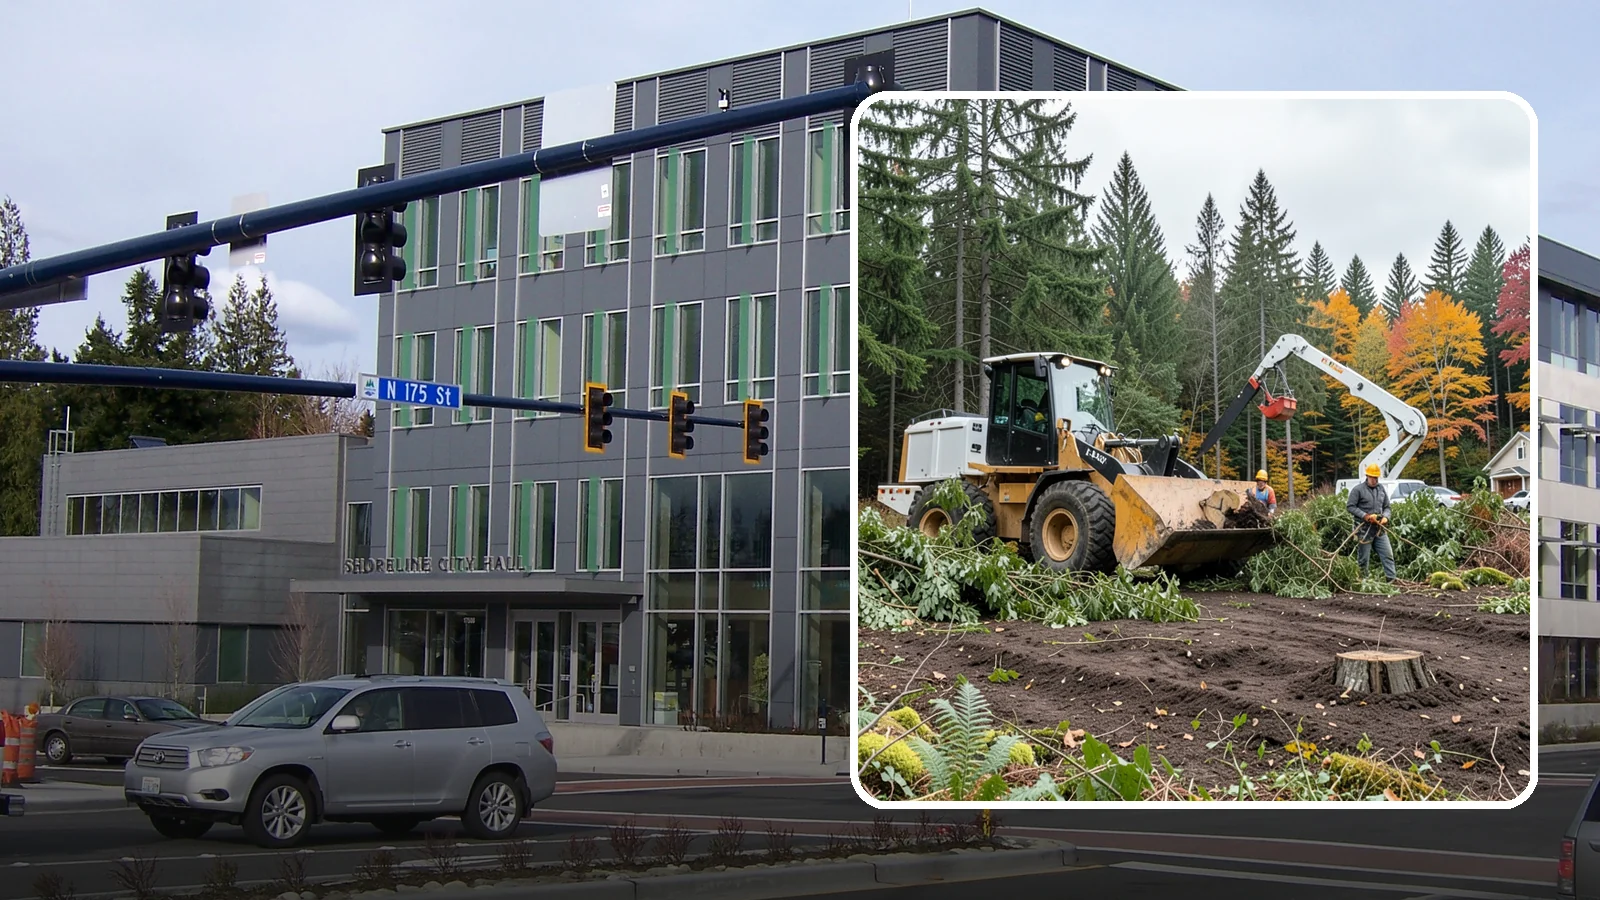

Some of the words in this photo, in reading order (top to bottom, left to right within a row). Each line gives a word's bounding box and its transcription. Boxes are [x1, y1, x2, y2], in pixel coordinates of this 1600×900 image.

[387, 380, 396, 400] N
[405, 382, 427, 403] 175
[436, 386, 451, 406] St
[344, 556, 432, 574] SHORELINE
[438, 555, 475, 572] CITY
[483, 554, 525, 571] HALL
